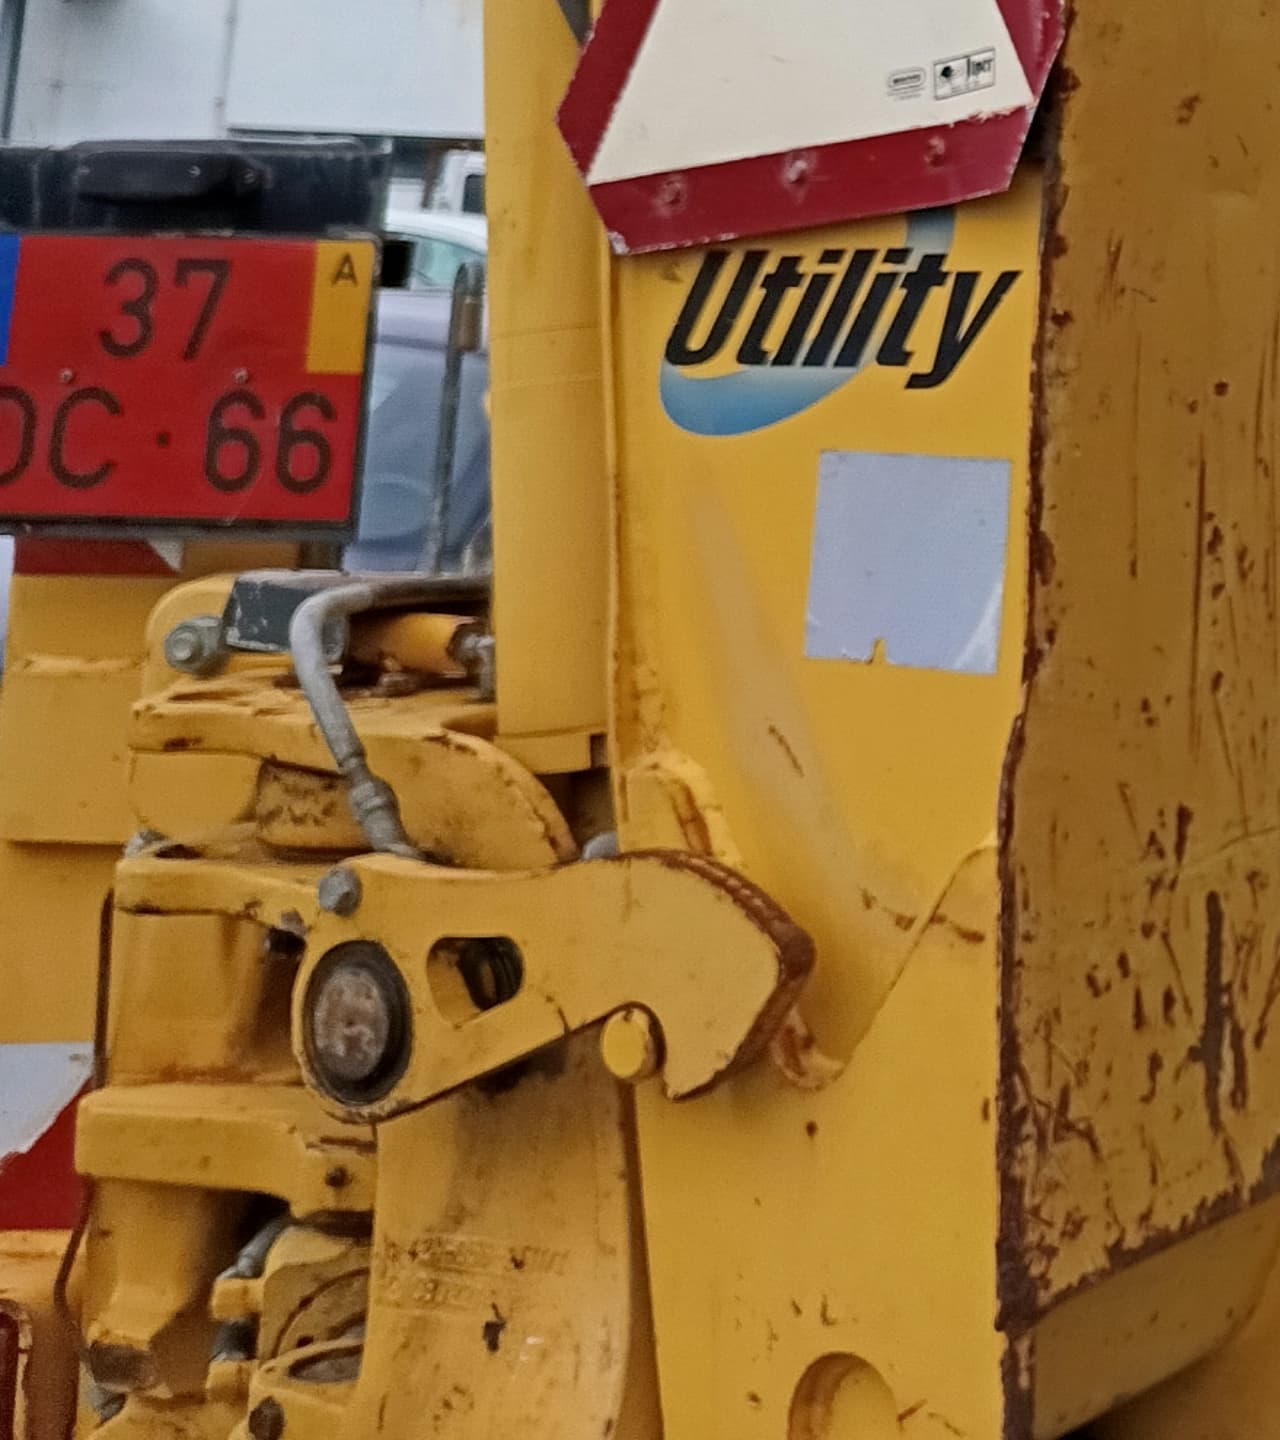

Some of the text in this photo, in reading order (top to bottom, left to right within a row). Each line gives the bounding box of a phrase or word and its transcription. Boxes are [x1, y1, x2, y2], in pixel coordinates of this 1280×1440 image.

[99, 257, 232, 360] 37
[331, 253, 359, 288] A
[664, 248, 1024, 389] Utility
